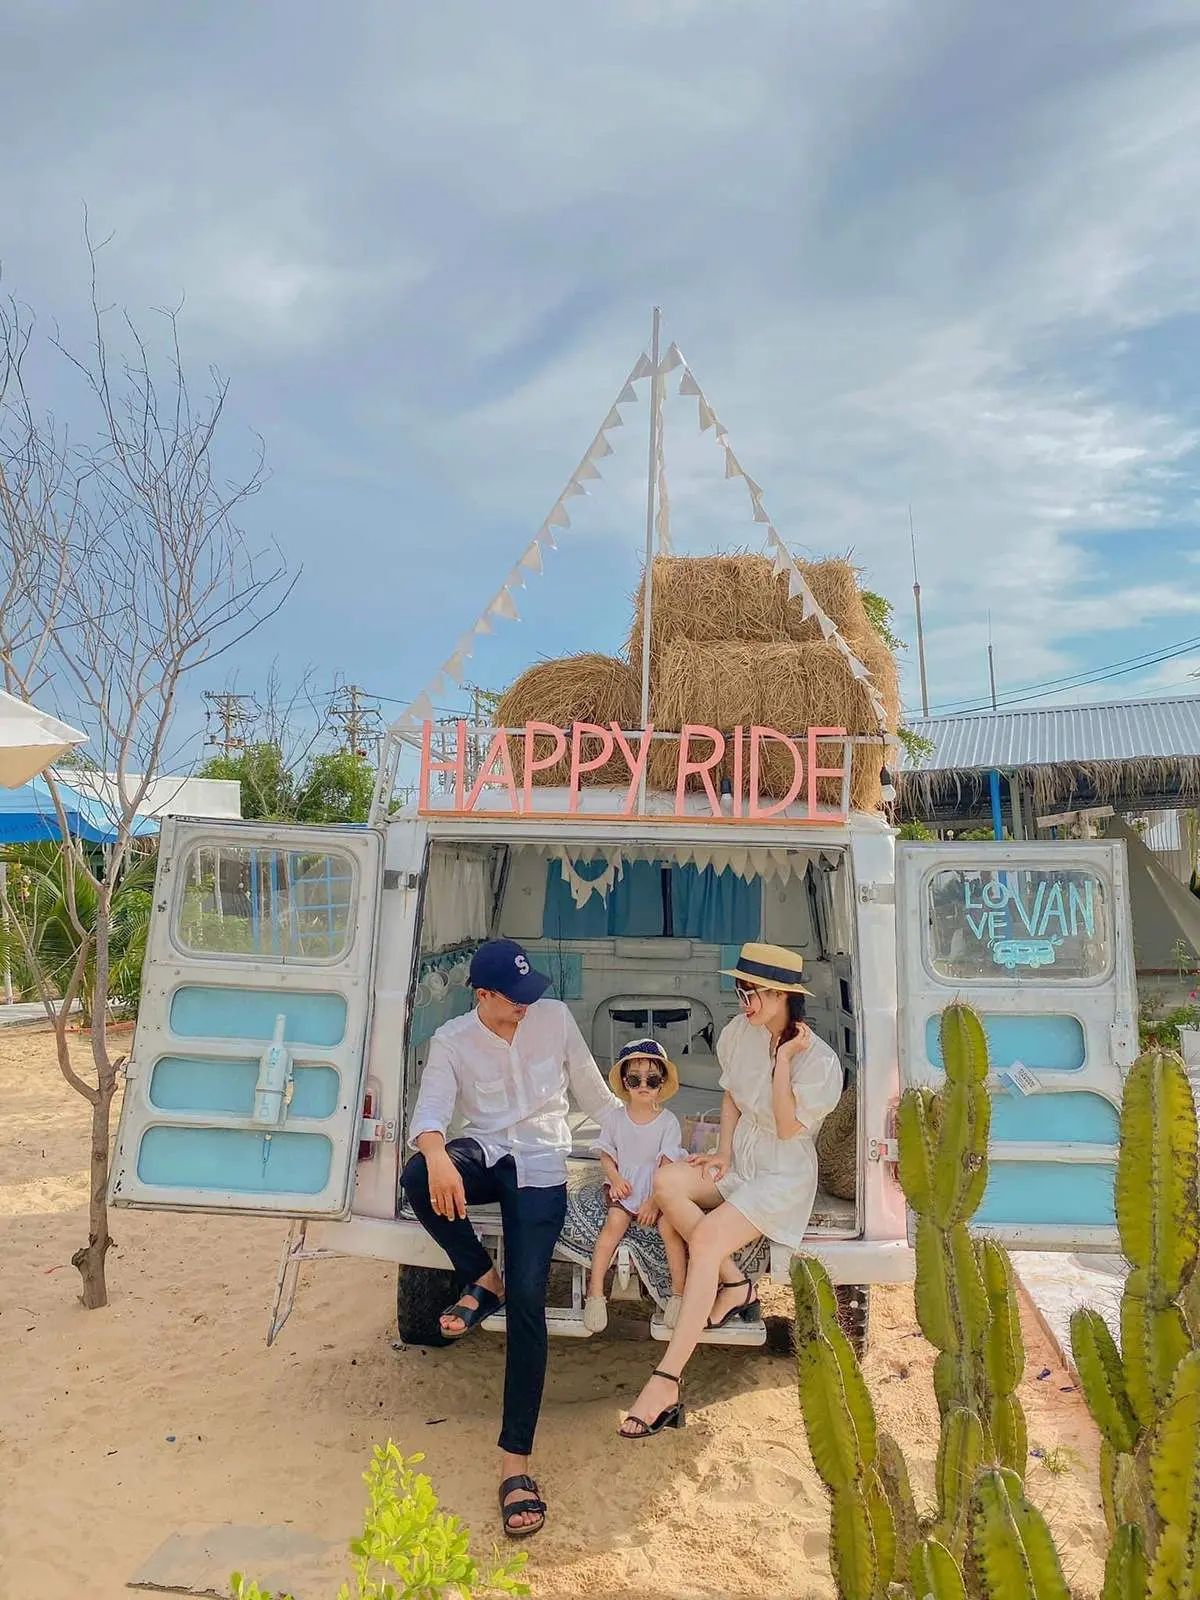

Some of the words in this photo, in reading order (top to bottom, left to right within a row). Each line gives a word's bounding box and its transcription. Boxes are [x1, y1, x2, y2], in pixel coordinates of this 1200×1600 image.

[418, 719, 654, 816] HAPPY
[675, 724, 848, 821] RIDE
[1010, 880, 1095, 936] VAN
[514, 954, 530, 975] S
